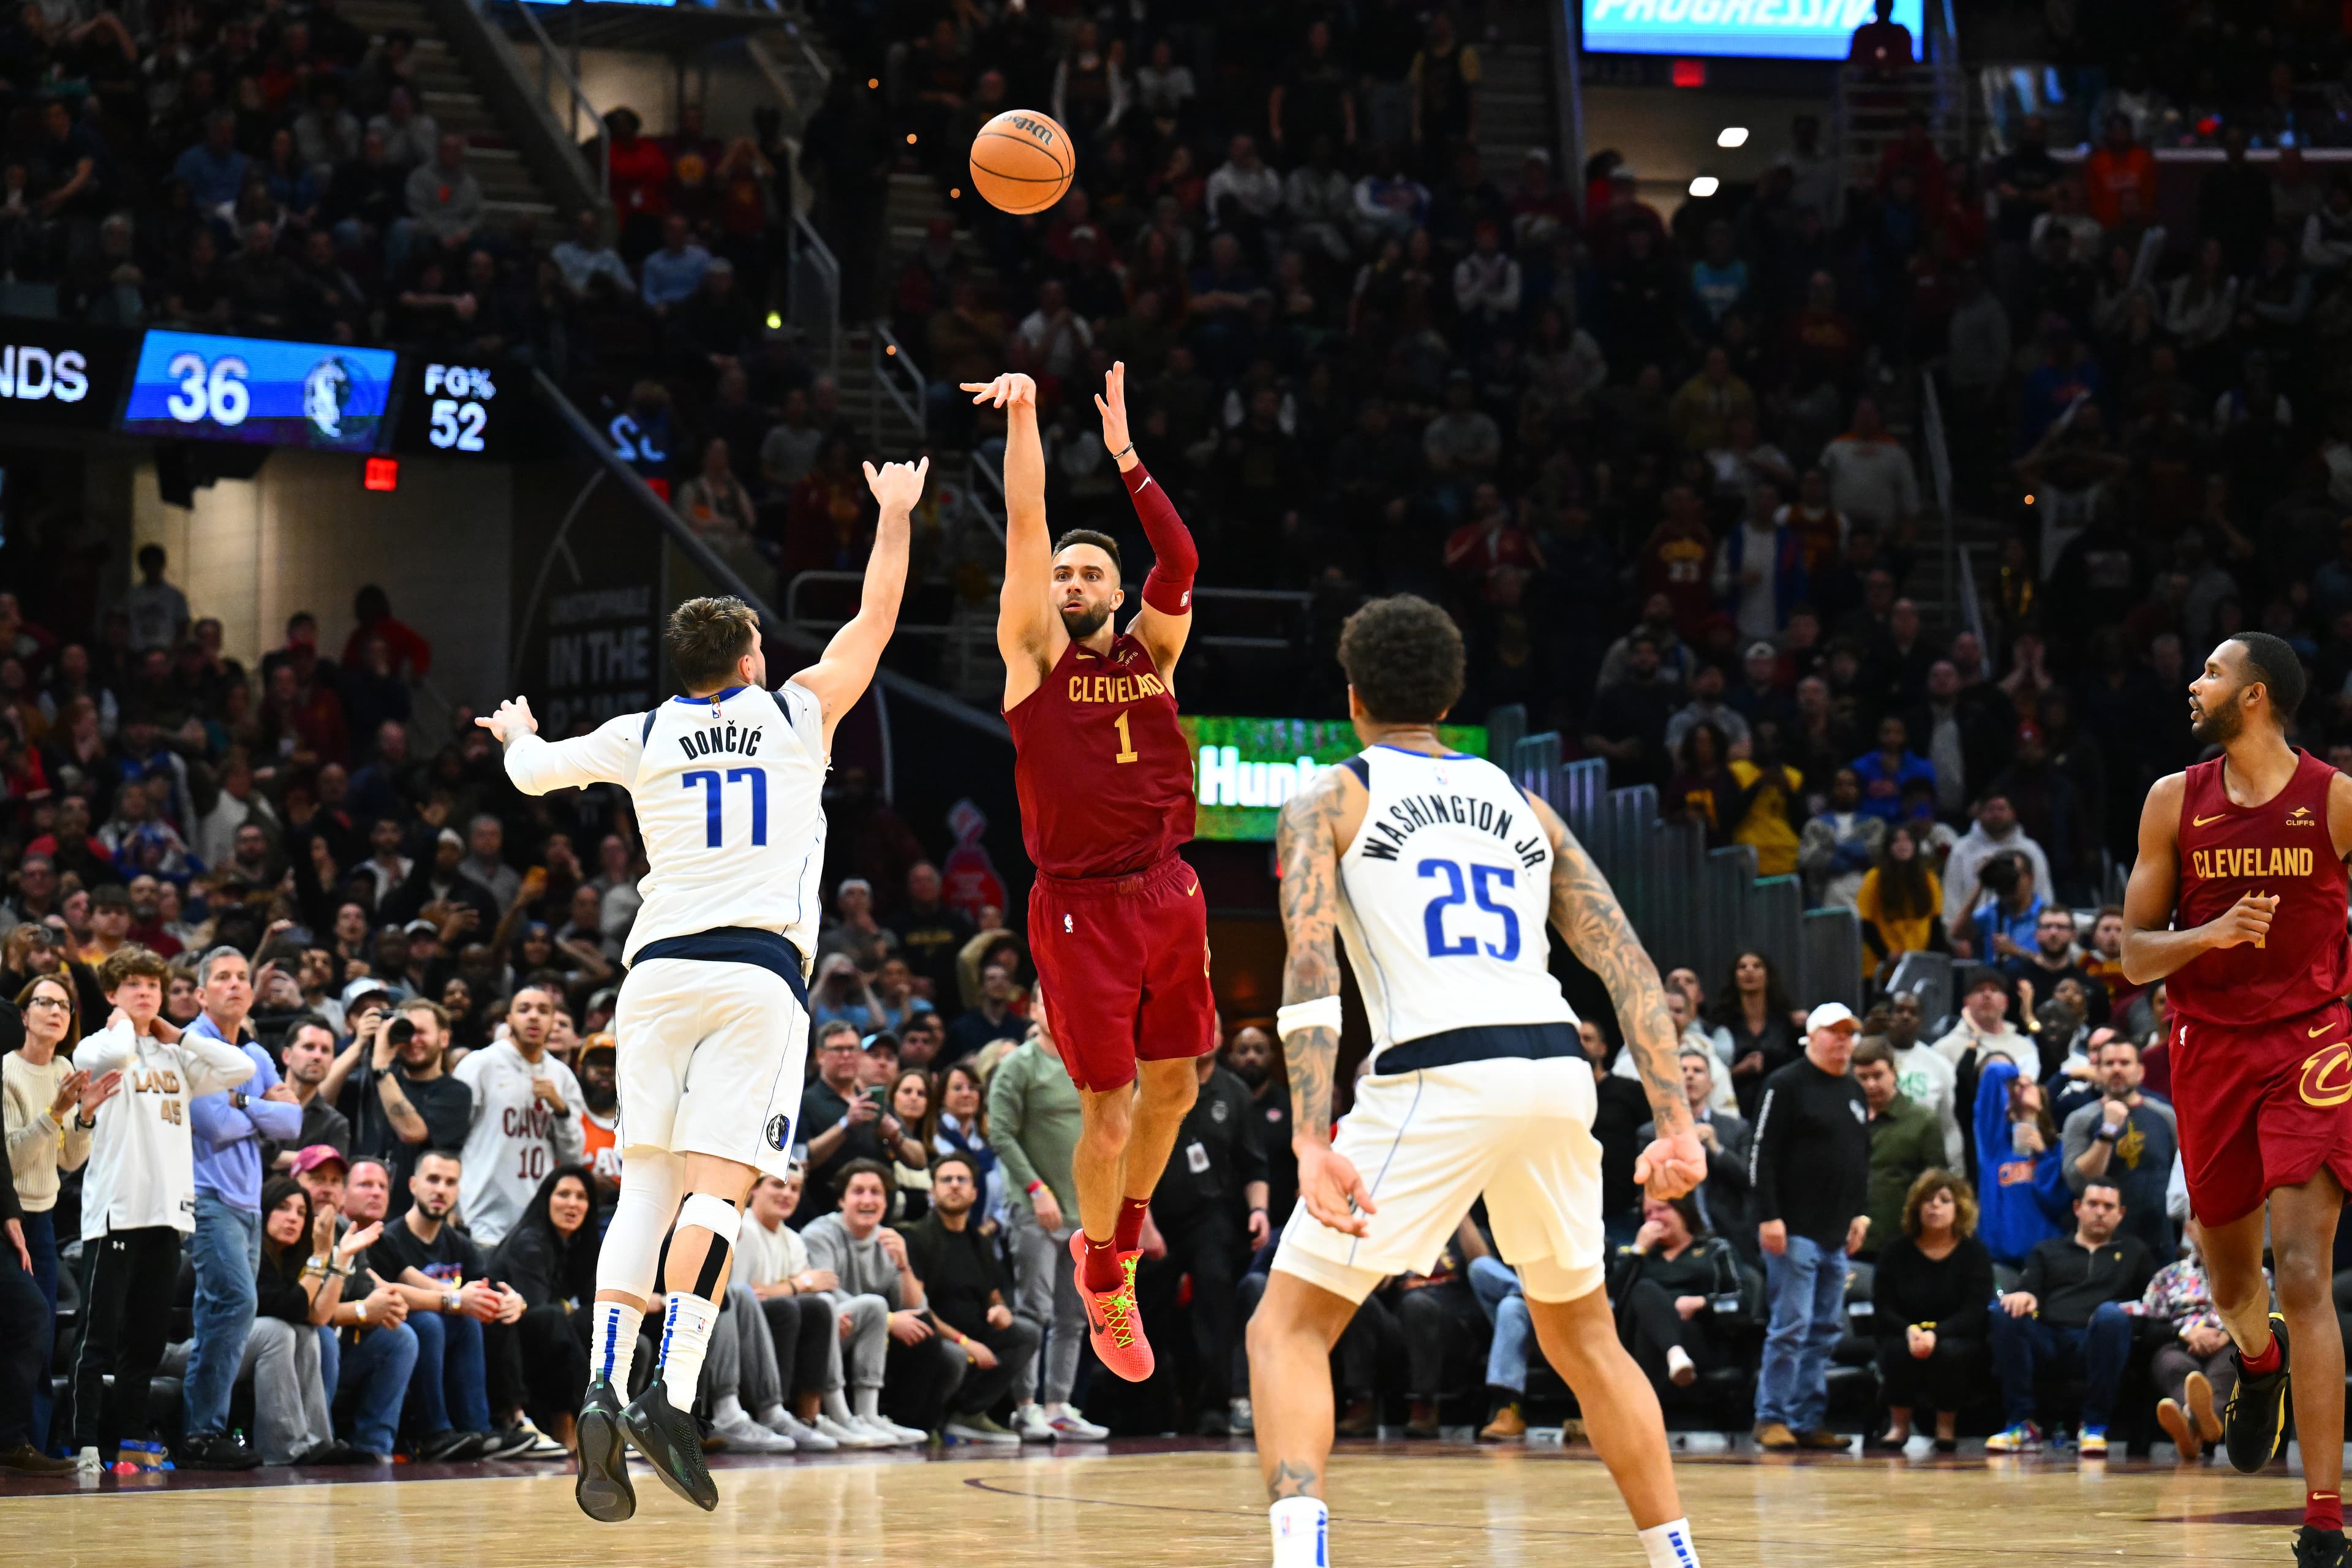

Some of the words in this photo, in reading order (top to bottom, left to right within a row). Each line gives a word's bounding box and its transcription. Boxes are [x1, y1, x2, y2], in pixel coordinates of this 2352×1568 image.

[1593, 0, 1879, 28] PROGRESSIV
[167, 353, 250, 426] 36
[424, 363, 497, 400] FG%
[429, 399, 488, 451] 52
[678, 720, 763, 761] DONČIĆ
[1114, 709, 1138, 764] 1
[682, 767, 767, 849] 77
[1362, 794, 1513, 862] WASHINGTON
[1514, 837, 1545, 877] JR.
[2192, 847, 2313, 878] CLEVELAND
[1417, 858, 1521, 962] 25
[161, 1099, 181, 1125] 45
[518, 1145, 545, 1180] 10
